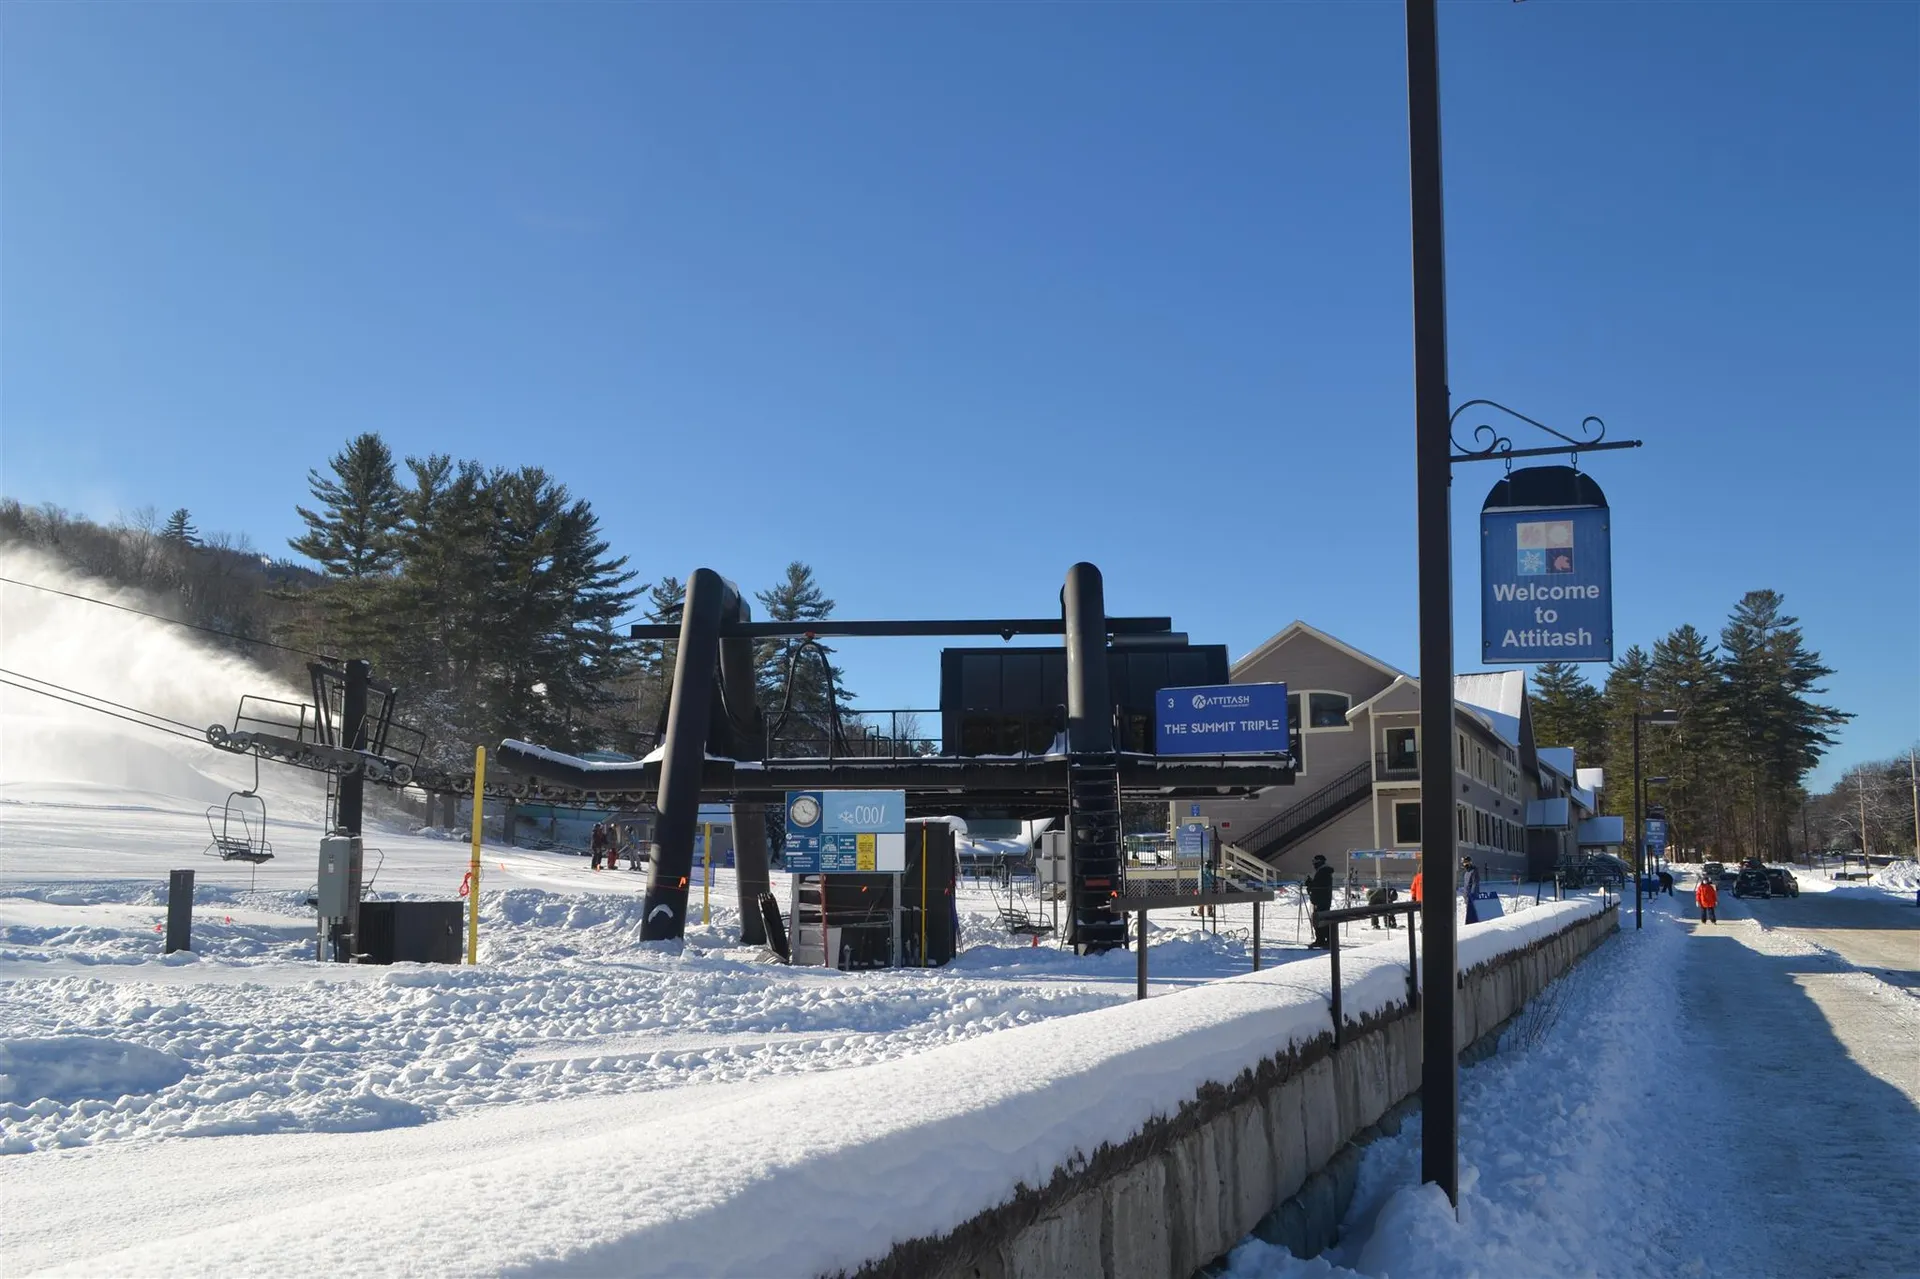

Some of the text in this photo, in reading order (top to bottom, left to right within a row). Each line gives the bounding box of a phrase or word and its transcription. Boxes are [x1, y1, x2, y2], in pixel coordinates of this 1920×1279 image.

[1493, 583, 1600, 602] Welcome
[1534, 606, 1558, 623] to
[1502, 628, 1592, 648] Attitash
[1167, 698, 1175, 709] 3
[1207, 695, 1250, 706] ATTITASH
[1164, 719, 1280, 735] THE SUMMIT TRIPLE
